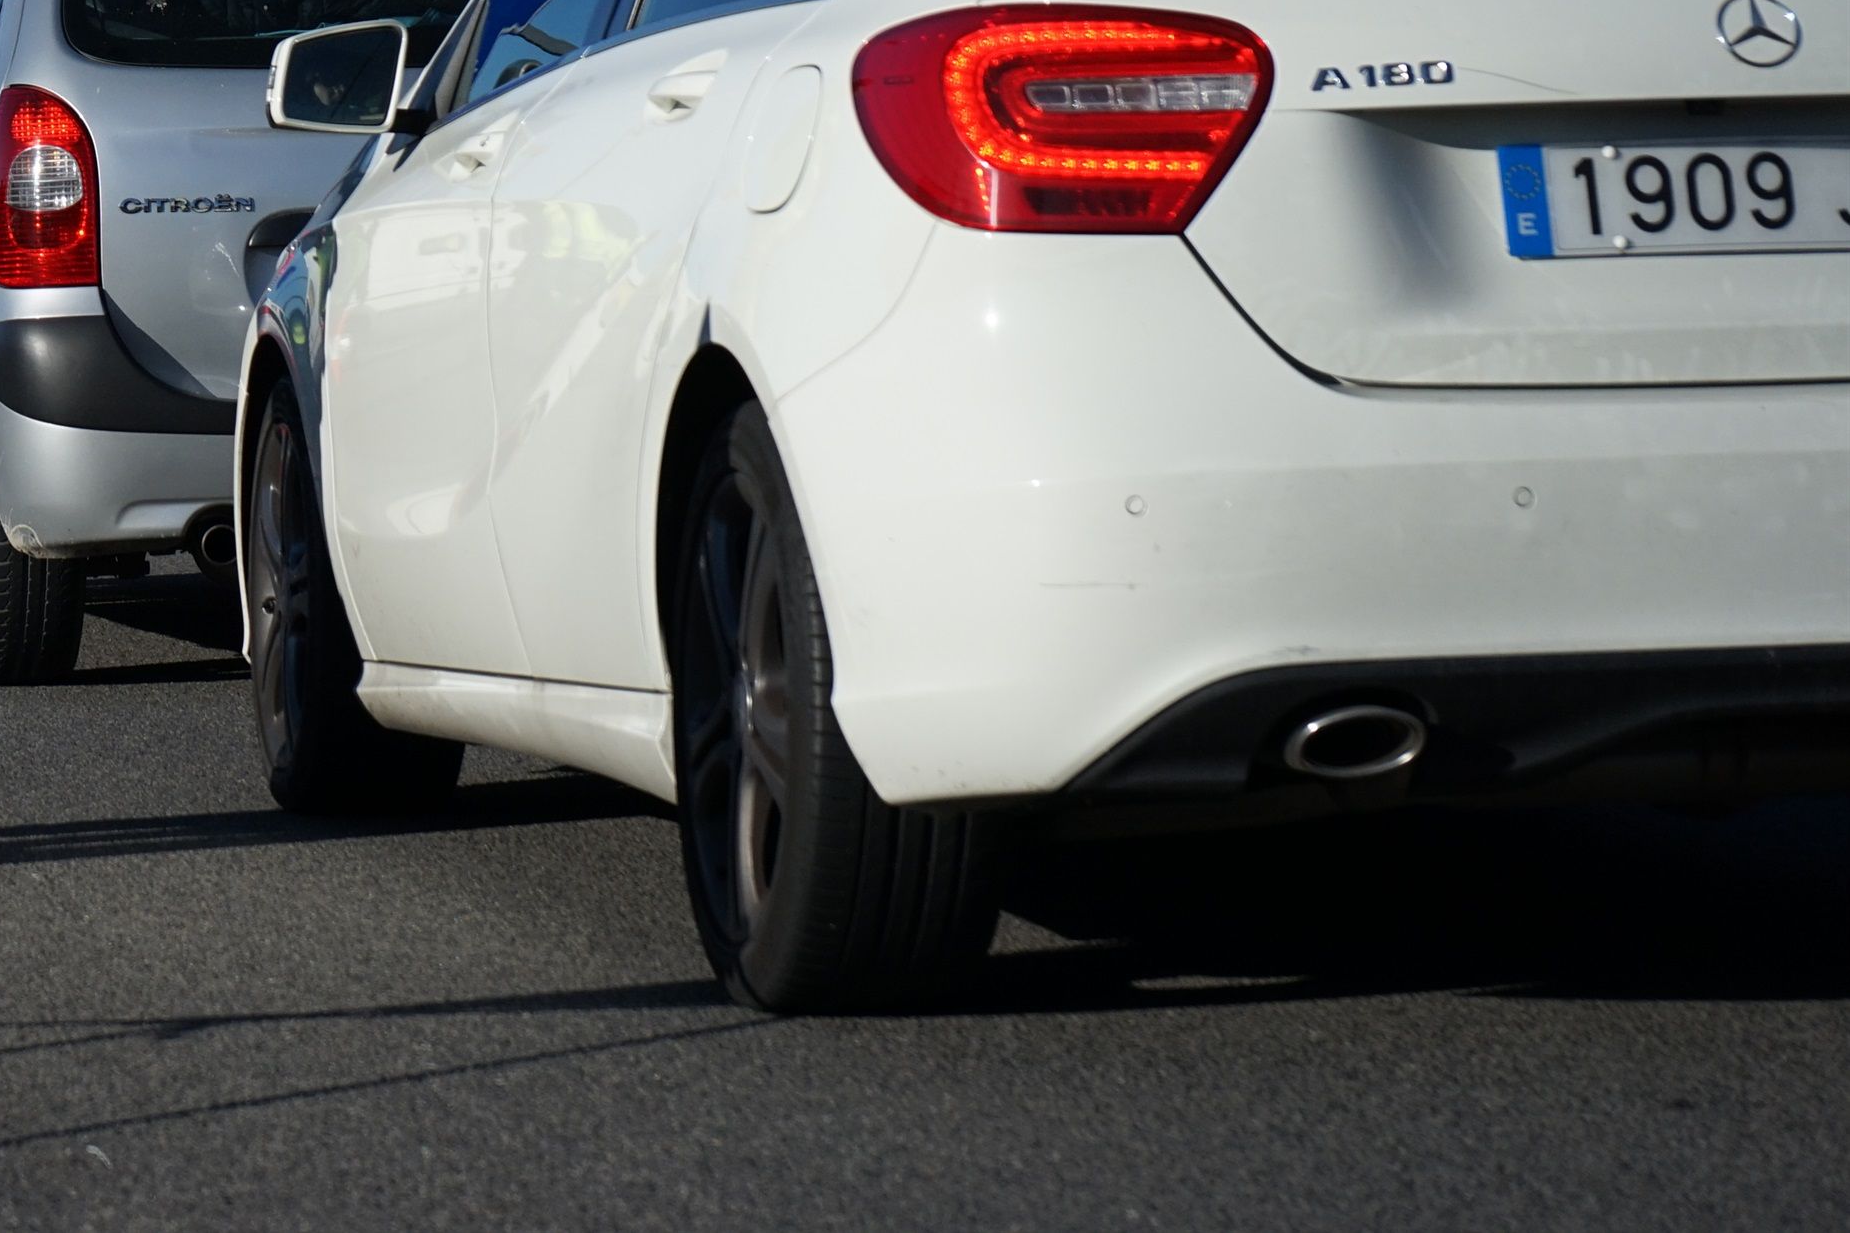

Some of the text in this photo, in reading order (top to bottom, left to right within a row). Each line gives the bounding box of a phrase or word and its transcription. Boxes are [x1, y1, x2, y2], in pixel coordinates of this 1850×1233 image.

[118, 193, 256, 215] CITROËN
[1573, 151, 1796, 236] 1909
[1516, 212, 1539, 236] E
